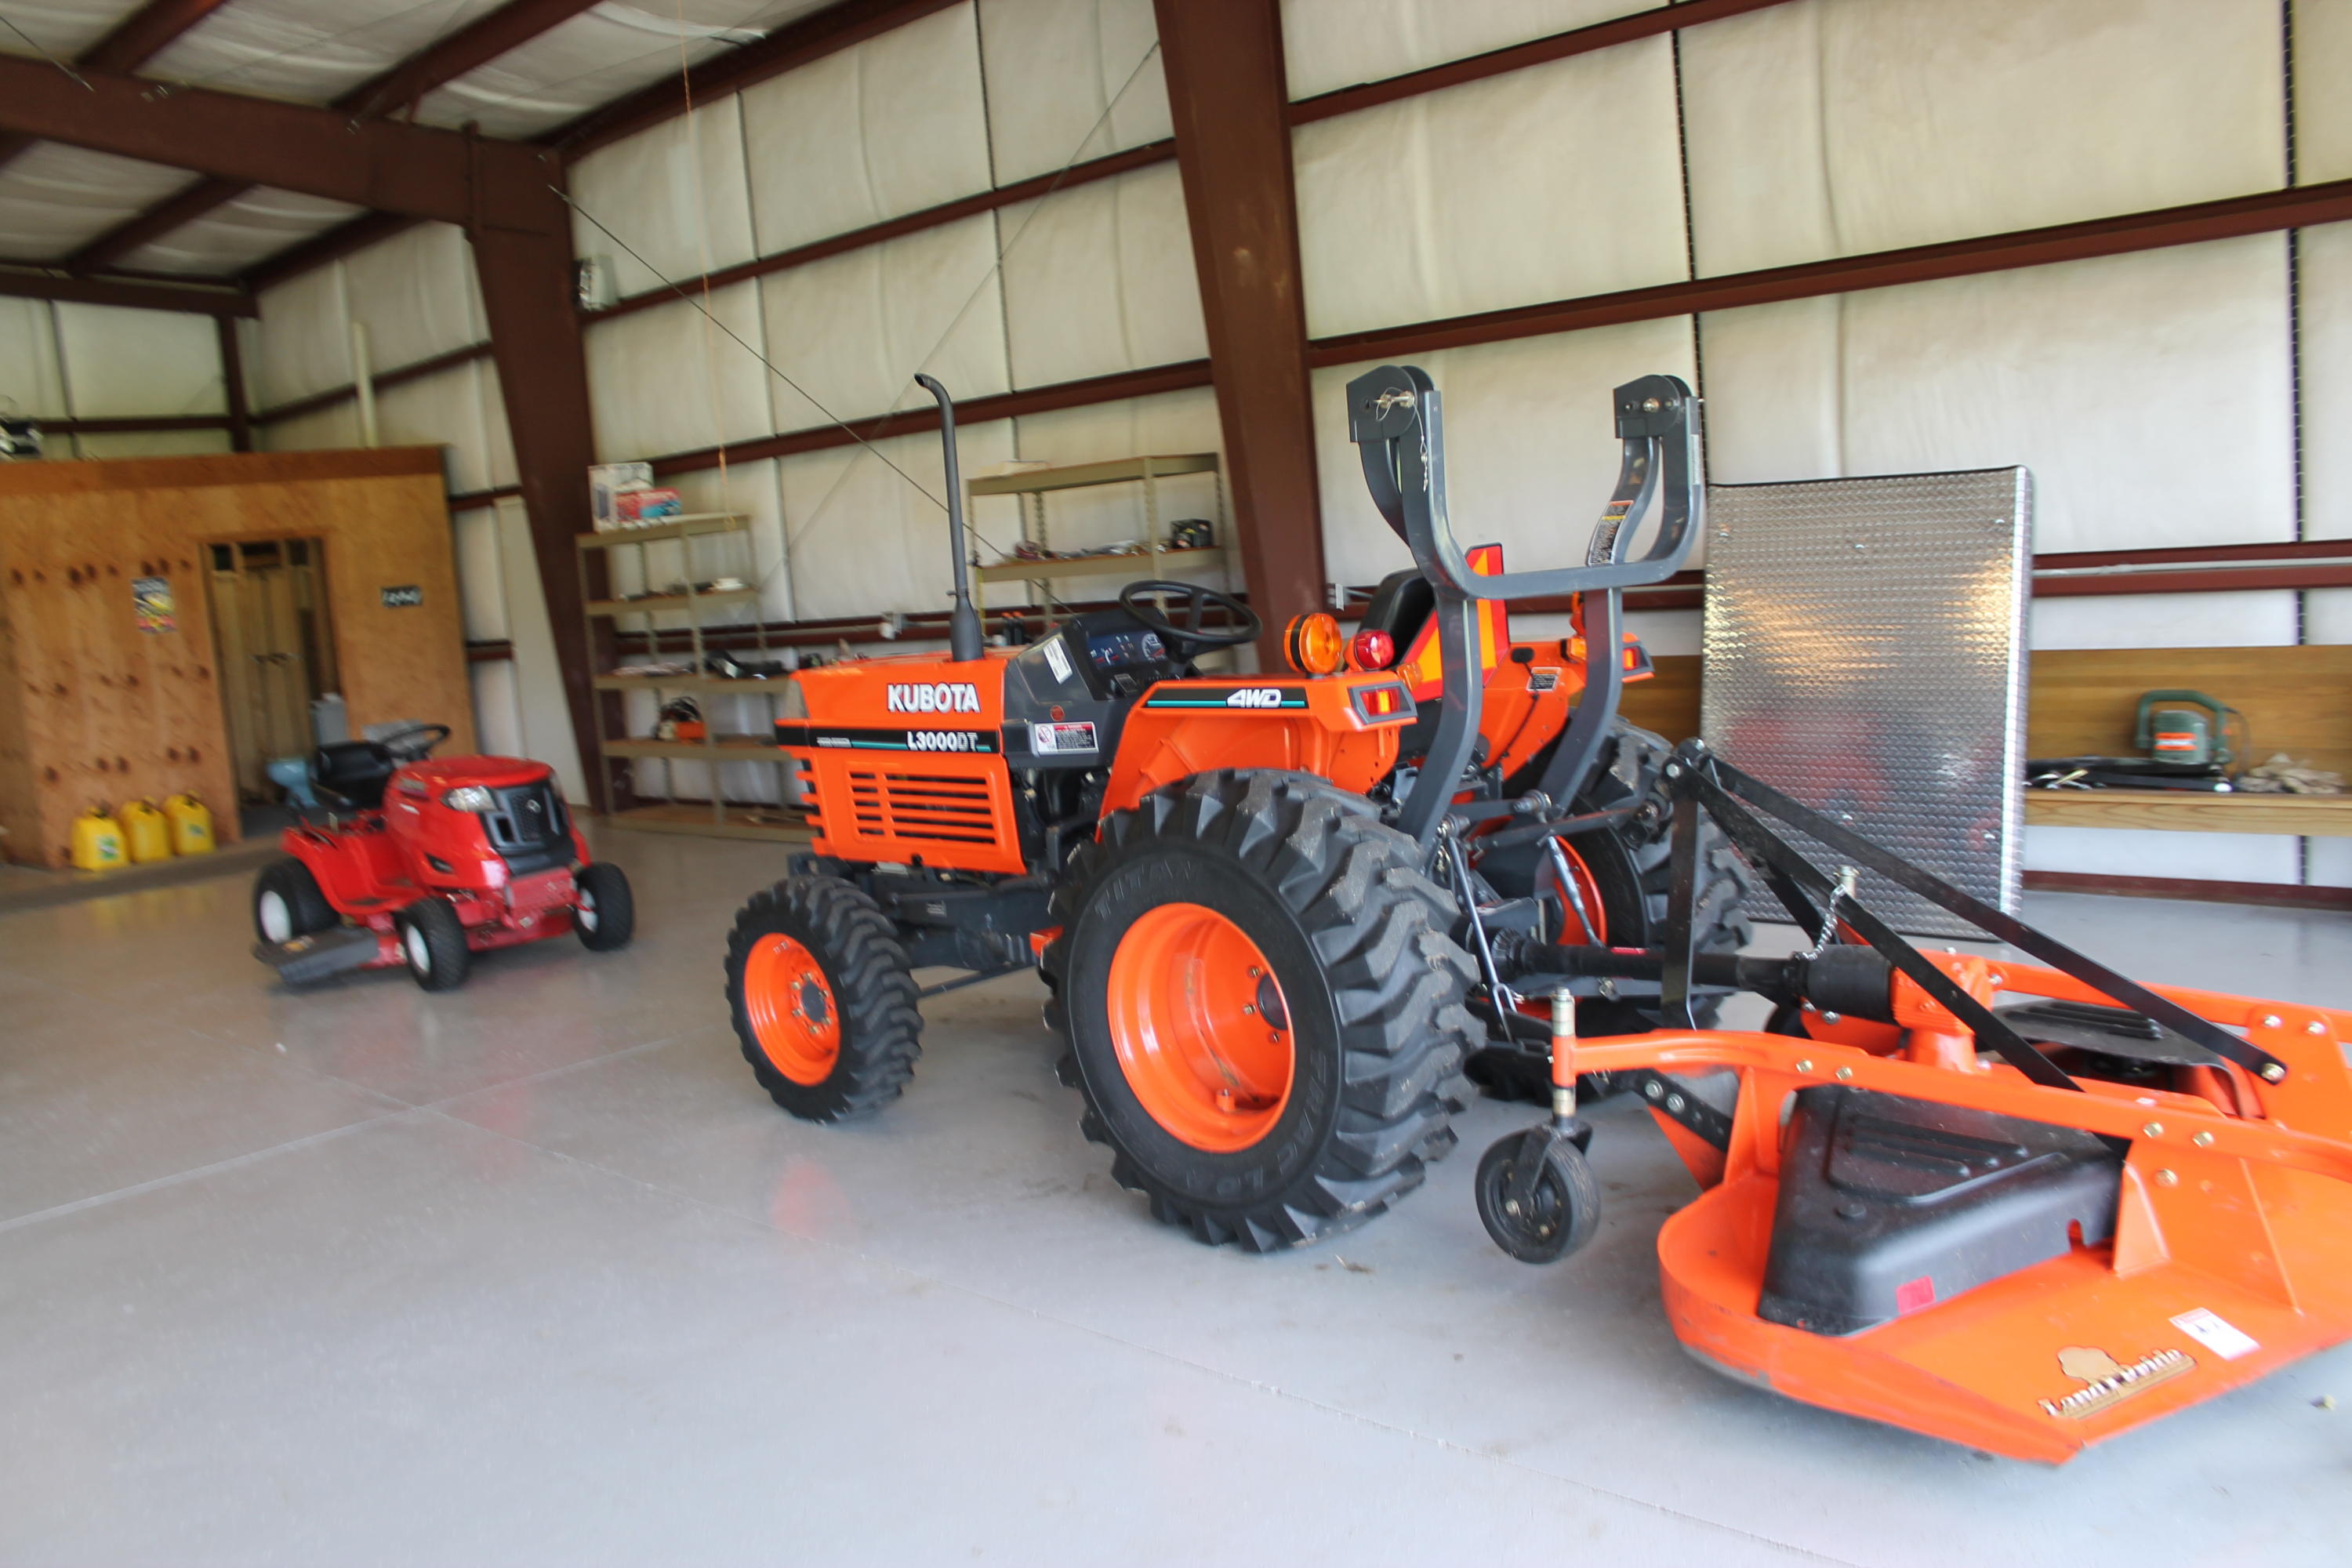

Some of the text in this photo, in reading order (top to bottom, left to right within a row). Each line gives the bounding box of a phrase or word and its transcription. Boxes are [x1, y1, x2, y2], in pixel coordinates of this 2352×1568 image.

[887, 682, 981, 713] KUBOTA
[1227, 688, 1282, 708] 4WD
[906, 731, 978, 752] L3000DT
[1093, 857, 1202, 920] TITAN
